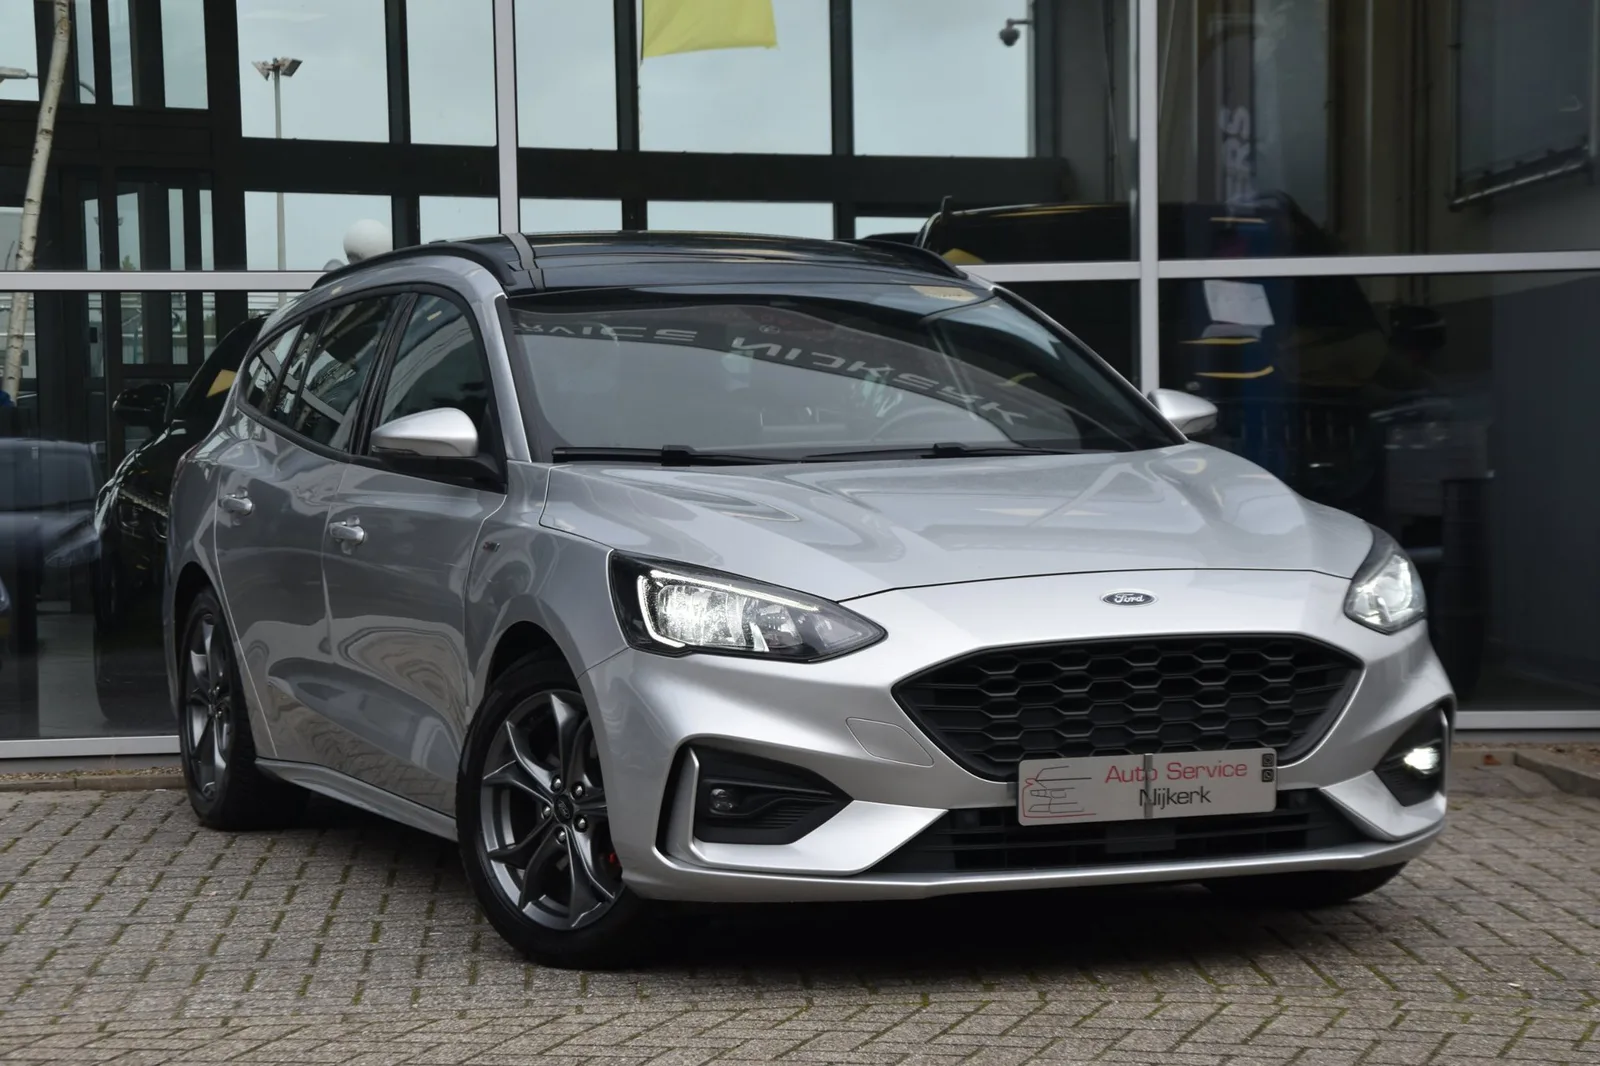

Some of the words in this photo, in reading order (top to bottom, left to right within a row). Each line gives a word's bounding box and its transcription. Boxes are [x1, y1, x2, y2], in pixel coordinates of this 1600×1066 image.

[1114, 593, 1145, 603] Ford
[1104, 764, 1158, 784] Auto
[1166, 760, 1248, 781] Service
[1139, 785, 1212, 810] Nijkerk
